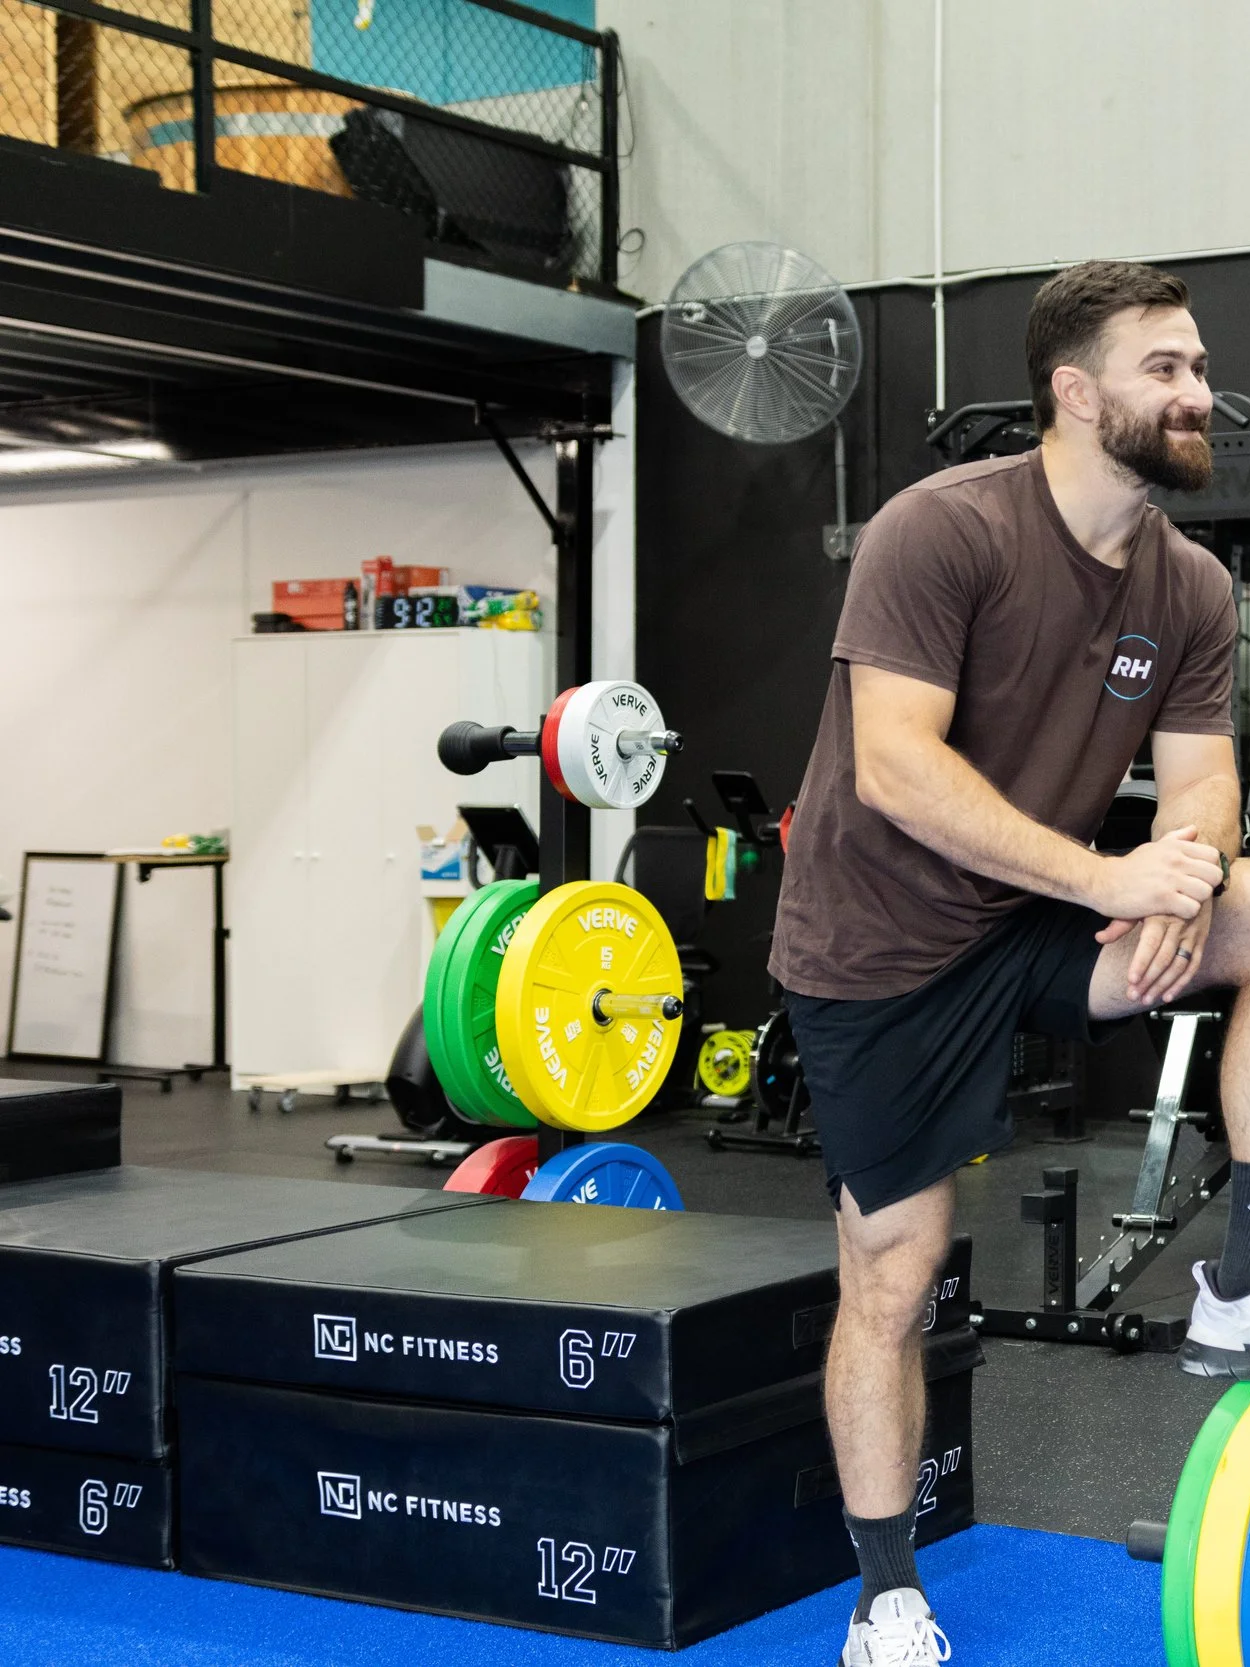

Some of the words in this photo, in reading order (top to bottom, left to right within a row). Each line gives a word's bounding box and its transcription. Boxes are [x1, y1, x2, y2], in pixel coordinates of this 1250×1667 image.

[1111, 655, 1153, 680] RH
[612, 694, 648, 717] VERVE
[591, 733, 608, 786] VERVE
[632, 755, 657, 794] VERVE
[577, 907, 639, 938] VERVE
[601, 946, 613, 961] 15
[601, 961, 612, 970] KG
[535, 1006, 568, 1090] VERVE
[626, 1018, 665, 1091] VERVE
[363, 1331, 394, 1353] NC
[402, 1336, 499, 1364] FITNESS
[367, 1489, 398, 1513] NC
[405, 1495, 501, 1527] FITNESS
